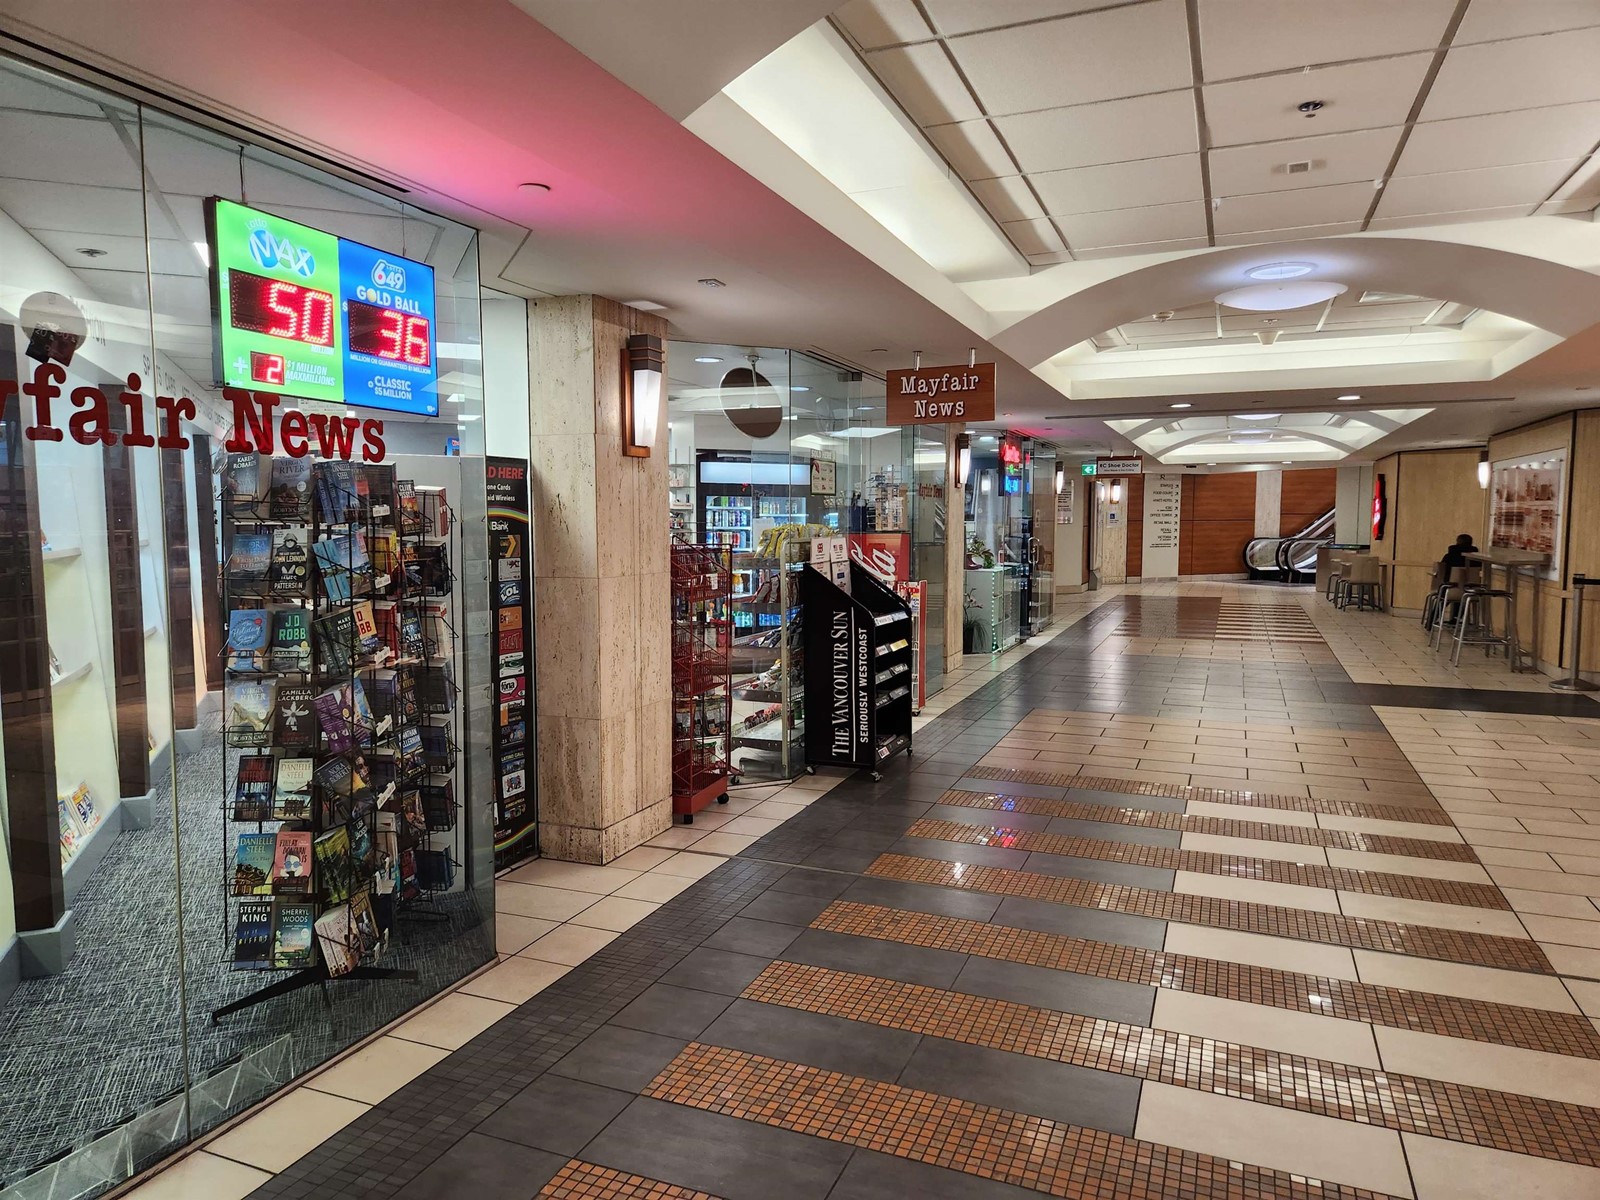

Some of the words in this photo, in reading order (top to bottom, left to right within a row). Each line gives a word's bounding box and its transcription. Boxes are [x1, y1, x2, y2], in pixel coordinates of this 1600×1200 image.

[250, 230, 314, 277] MAX
[356, 285, 391, 306] GOLD
[395, 295, 422, 315] BALL
[268, 281, 332, 344] 50
[379, 309, 429, 365] 36
[266, 355, 283, 384] 2
[287, 360, 296, 370] $1
[296, 361, 328, 376] MILLION
[286, 370, 335, 386] MAXMILLIONS
[374, 375, 412, 391] CLASSIC
[900, 373, 979, 397] Mayfair
[374, 386, 383, 396] $5
[383, 388, 412, 400] MILLION
[914, 400, 964, 418] News
[222, 388, 386, 463] News
[280, 465, 305, 474] RIVER
[498, 467, 524, 480] HERE
[497, 483, 511, 491] Cards
[495, 494, 516, 502] Wireless
[337, 622, 352, 631] KUBIC
[830, 611, 848, 639] SUN
[279, 628, 306, 640] ROBB
[858, 628, 868, 687] WESTCOAST
[831, 643, 849, 725] VANCOUVER
[859, 690, 869, 743] SERIOUSLY
[831, 727, 850, 756] THE
[281, 763, 312, 771] DANIELLE
[240, 837, 273, 846] DANIELLE
[246, 846, 266, 854] STEEL
[240, 905, 271, 913] STEPHEN
[281, 908, 309, 916] SHERRYL
[241, 914, 267, 922] KING
